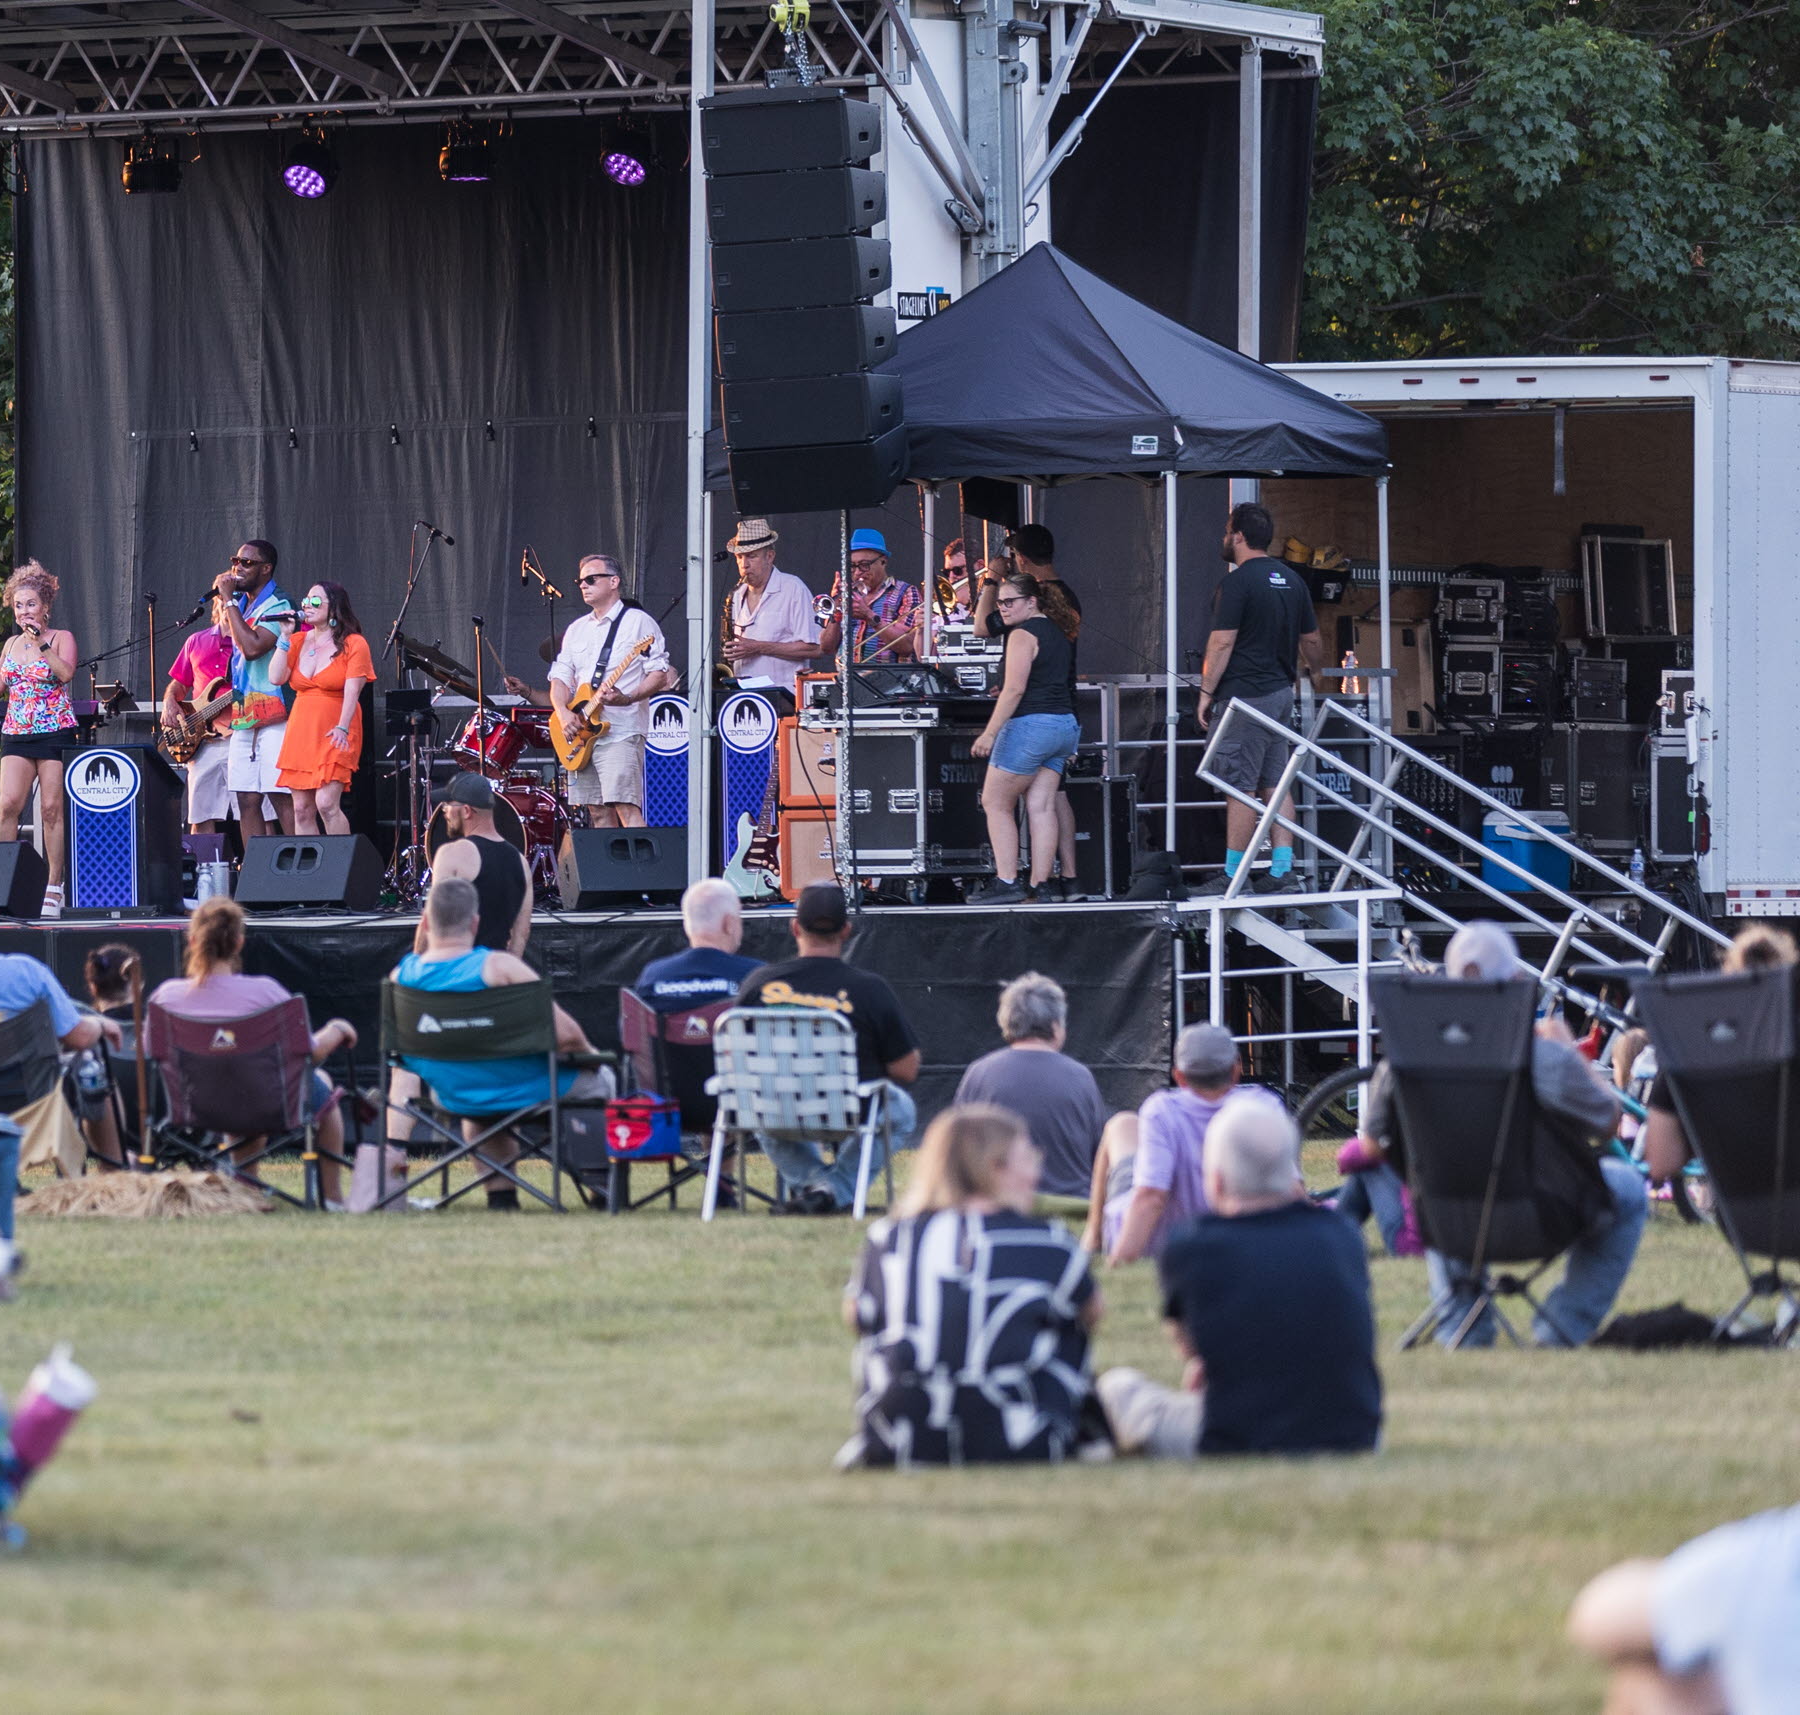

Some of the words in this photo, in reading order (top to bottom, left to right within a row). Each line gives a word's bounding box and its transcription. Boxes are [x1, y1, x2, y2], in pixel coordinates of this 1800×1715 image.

[899, 295, 927, 317] STAGELINE
[727, 729, 754, 737] CENTRAL
[755, 728, 769, 736] CITY
[76, 787, 112, 795] CENTRAL
[112, 786, 130, 795] CITY
[654, 977, 728, 994] Goodwill
